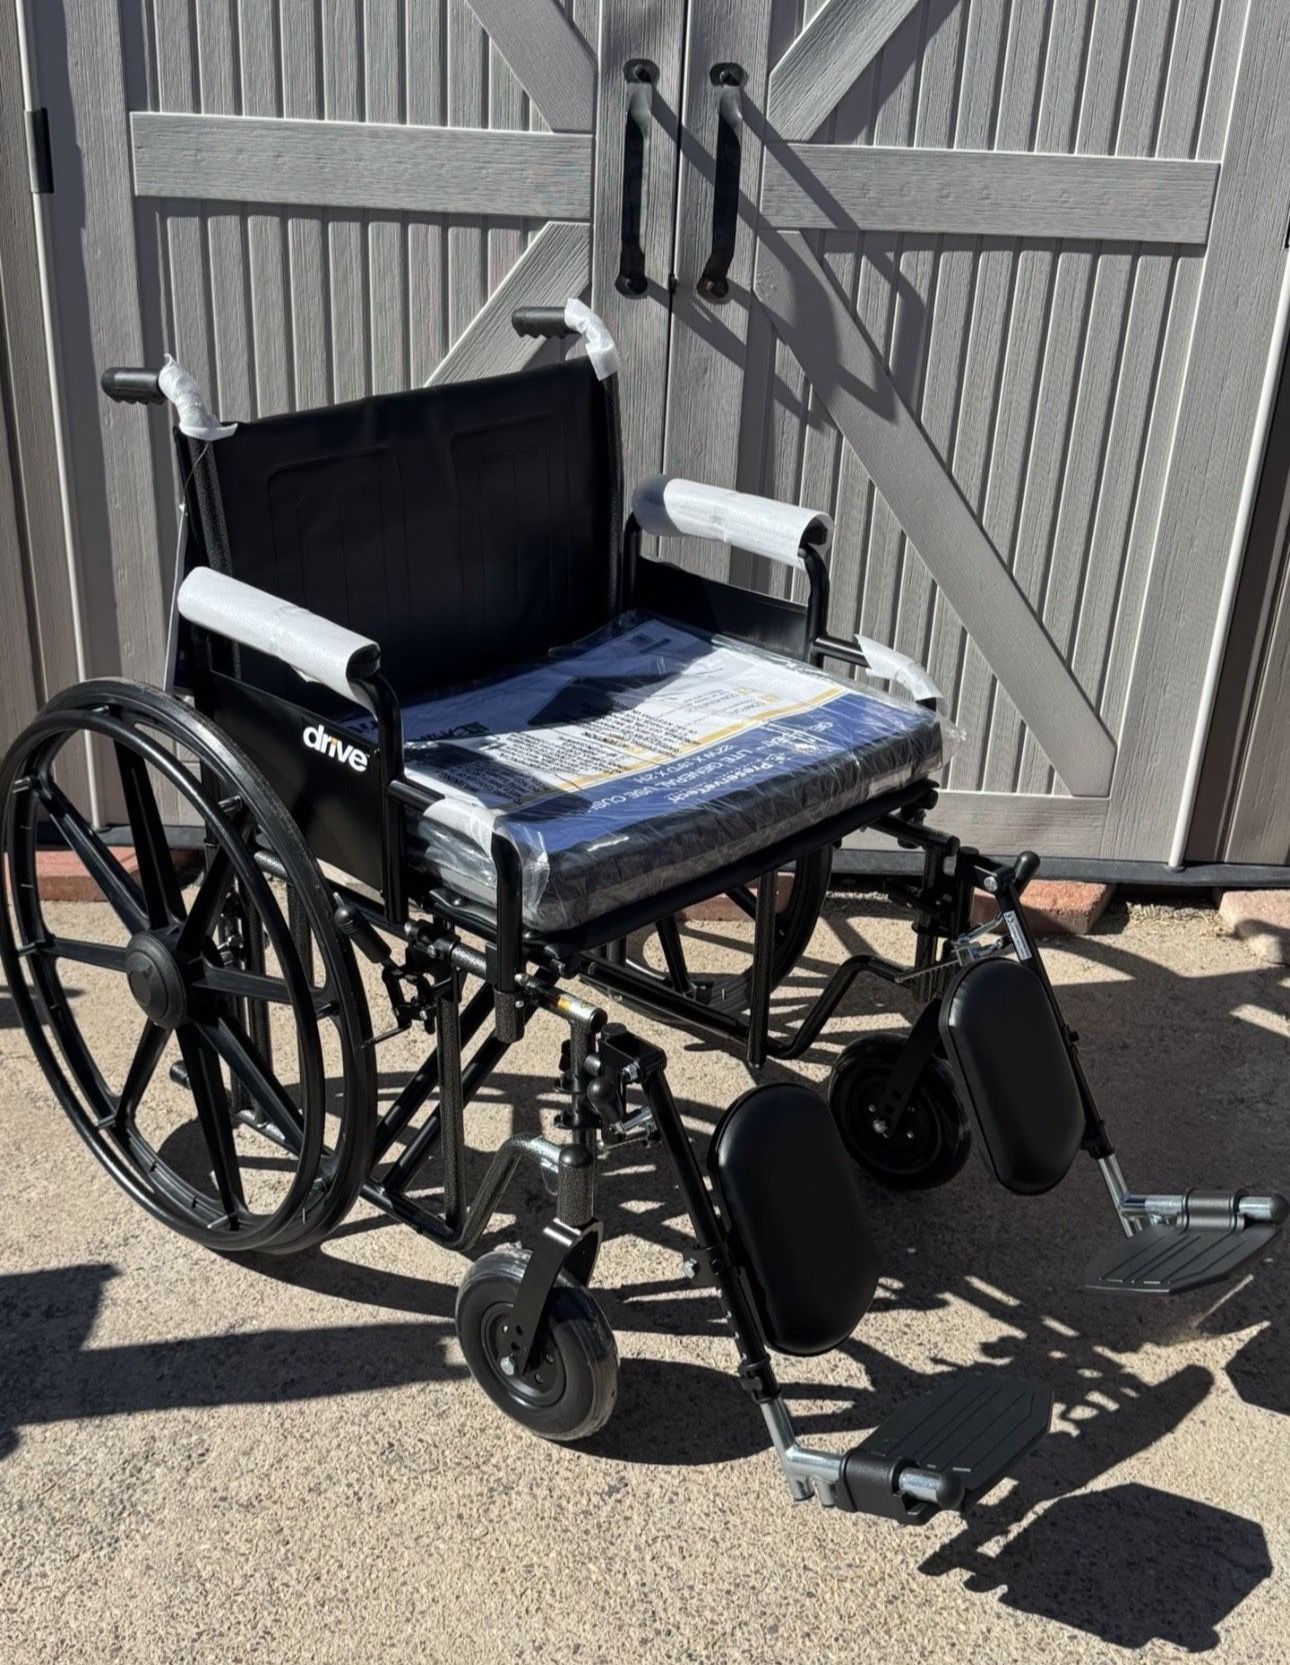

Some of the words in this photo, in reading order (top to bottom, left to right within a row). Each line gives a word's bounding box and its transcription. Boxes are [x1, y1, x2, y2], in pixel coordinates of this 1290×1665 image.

[303, 724, 368, 772] drive
[655, 761, 723, 788] GENERAL
[624, 785, 658, 800] USE
